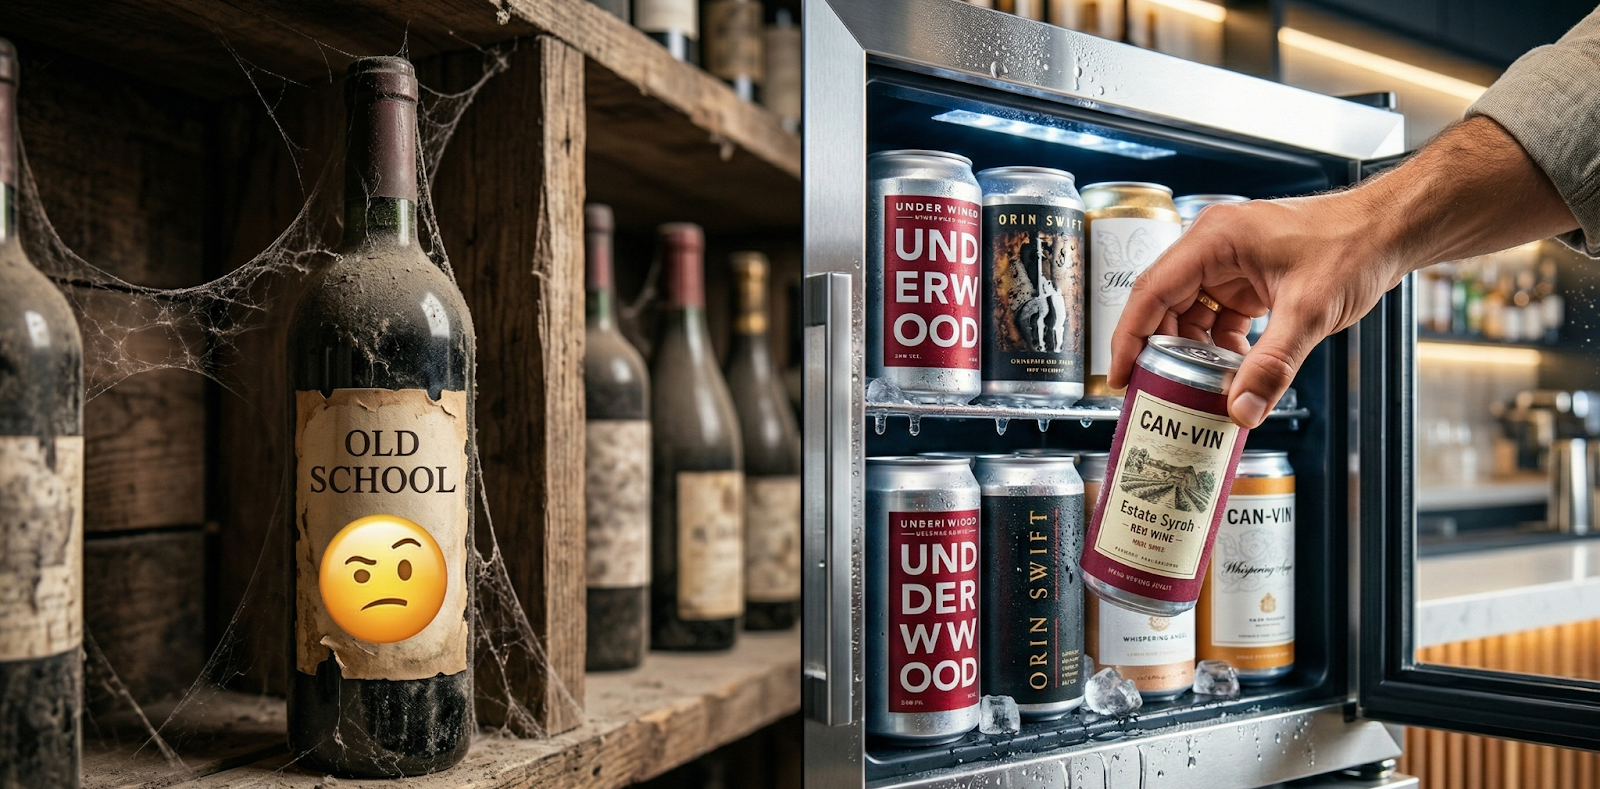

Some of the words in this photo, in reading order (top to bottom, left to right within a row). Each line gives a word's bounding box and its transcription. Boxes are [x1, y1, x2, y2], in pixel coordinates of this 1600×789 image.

[895, 202, 942, 213] UNDER
[998, 213, 1037, 226] ORIN
[1046, 215, 1083, 232] SWIFT
[895, 228, 978, 265] UND
[895, 270, 979, 307] ERW
[893, 312, 978, 348] OOD
[344, 429, 420, 457] OLD
[1139, 410, 1225, 450] CAN-VIN
[310, 465, 456, 494] SCHOOL
[1120, 499, 1157, 524] Estate
[1227, 505, 1292, 525] CAN-VIN
[1150, 529, 1175, 544] WINE
[900, 541, 978, 576] UND
[1029, 510, 1048, 600] SWIFT
[1221, 560, 1275, 579] Whispering
[901, 579, 976, 615] DER
[1029, 617, 1048, 690] ORIN
[1122, 633, 1169, 643] WHISPERING
[900, 656, 978, 693] OOD
